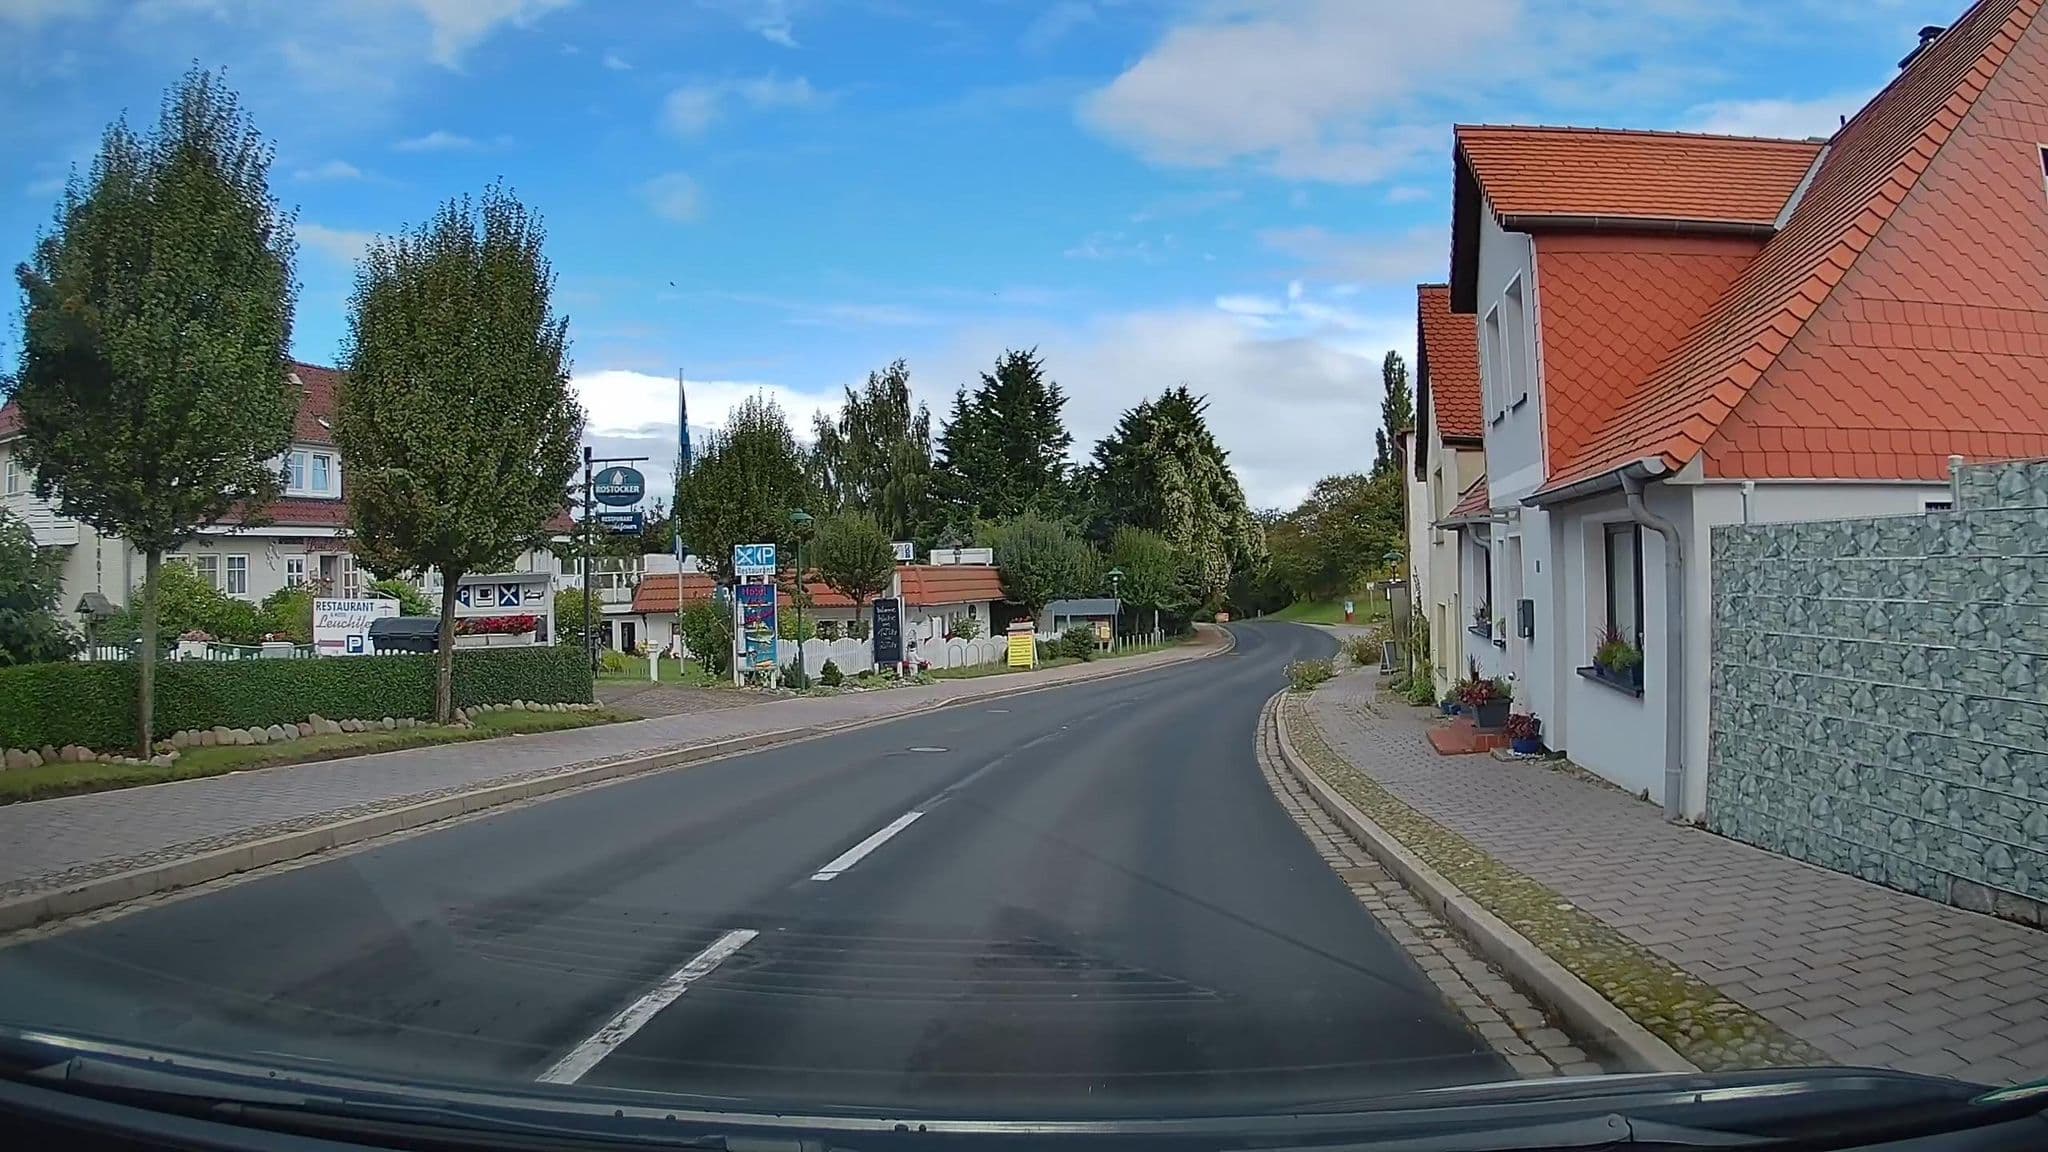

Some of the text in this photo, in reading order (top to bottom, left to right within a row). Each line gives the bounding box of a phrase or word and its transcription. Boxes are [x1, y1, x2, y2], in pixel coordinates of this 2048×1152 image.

[595, 485, 640, 493] ROSTOCKER
[315, 601, 374, 612] RESTAURANT
[315, 615, 373, 631] Leuchtfe
